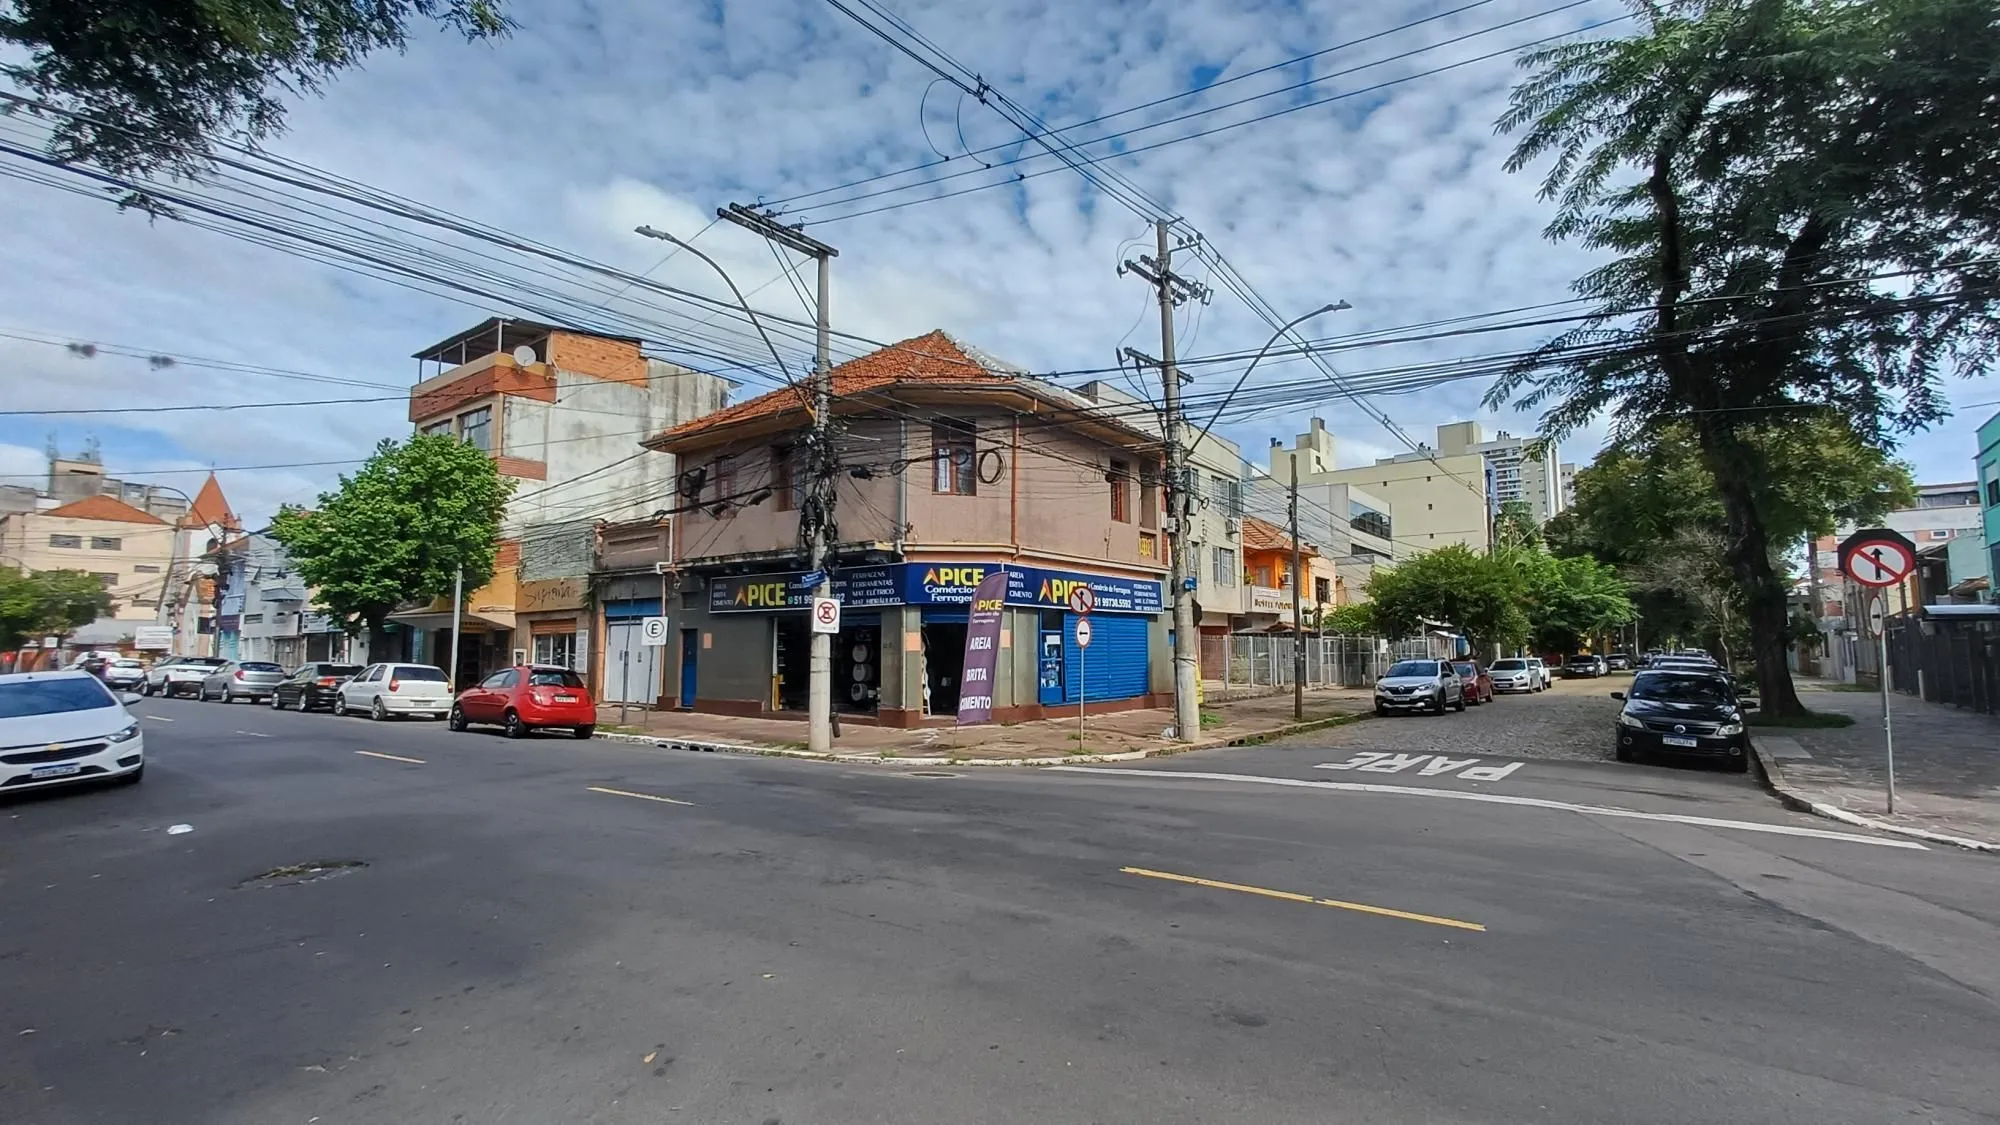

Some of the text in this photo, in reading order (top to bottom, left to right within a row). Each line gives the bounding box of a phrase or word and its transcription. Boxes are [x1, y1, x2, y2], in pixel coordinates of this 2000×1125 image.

[1009, 571, 1024, 579] AREIA
[852, 579, 894, 588] FERRAMENTAS
[866, 587, 895, 596] ELÉTRICO
[925, 585, 974, 594] Comércio
[1009, 590, 1033, 599] CIMENTO
[794, 595, 802, 605] 51
[1094, 597, 1101, 606] 51
[651, 623, 659, 635] E
[970, 636, 992, 650] AREIA
[966, 667, 987, 682] BRITA
[960, 696, 992, 711] CIMENTO
[1312, 751, 1526, 782] PARE
